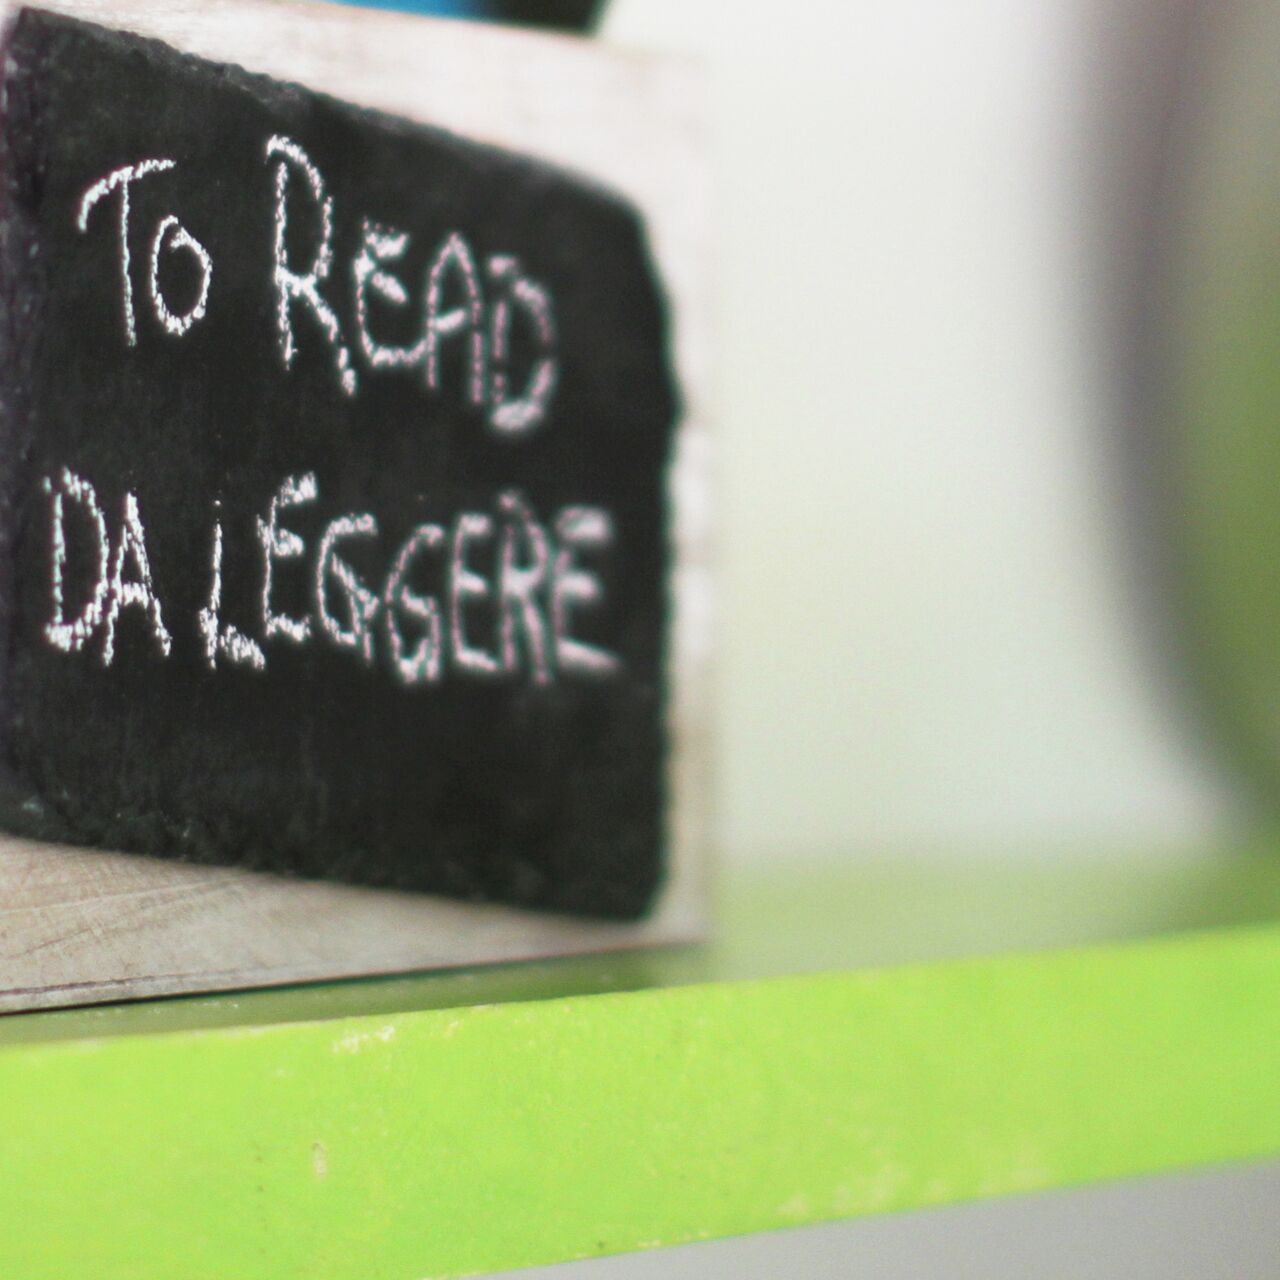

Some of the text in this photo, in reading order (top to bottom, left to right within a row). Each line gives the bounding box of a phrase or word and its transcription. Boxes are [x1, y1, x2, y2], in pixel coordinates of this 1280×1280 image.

[265, 134, 558, 431] READ
[43, 466, 621, 687] DA LEGGERE
